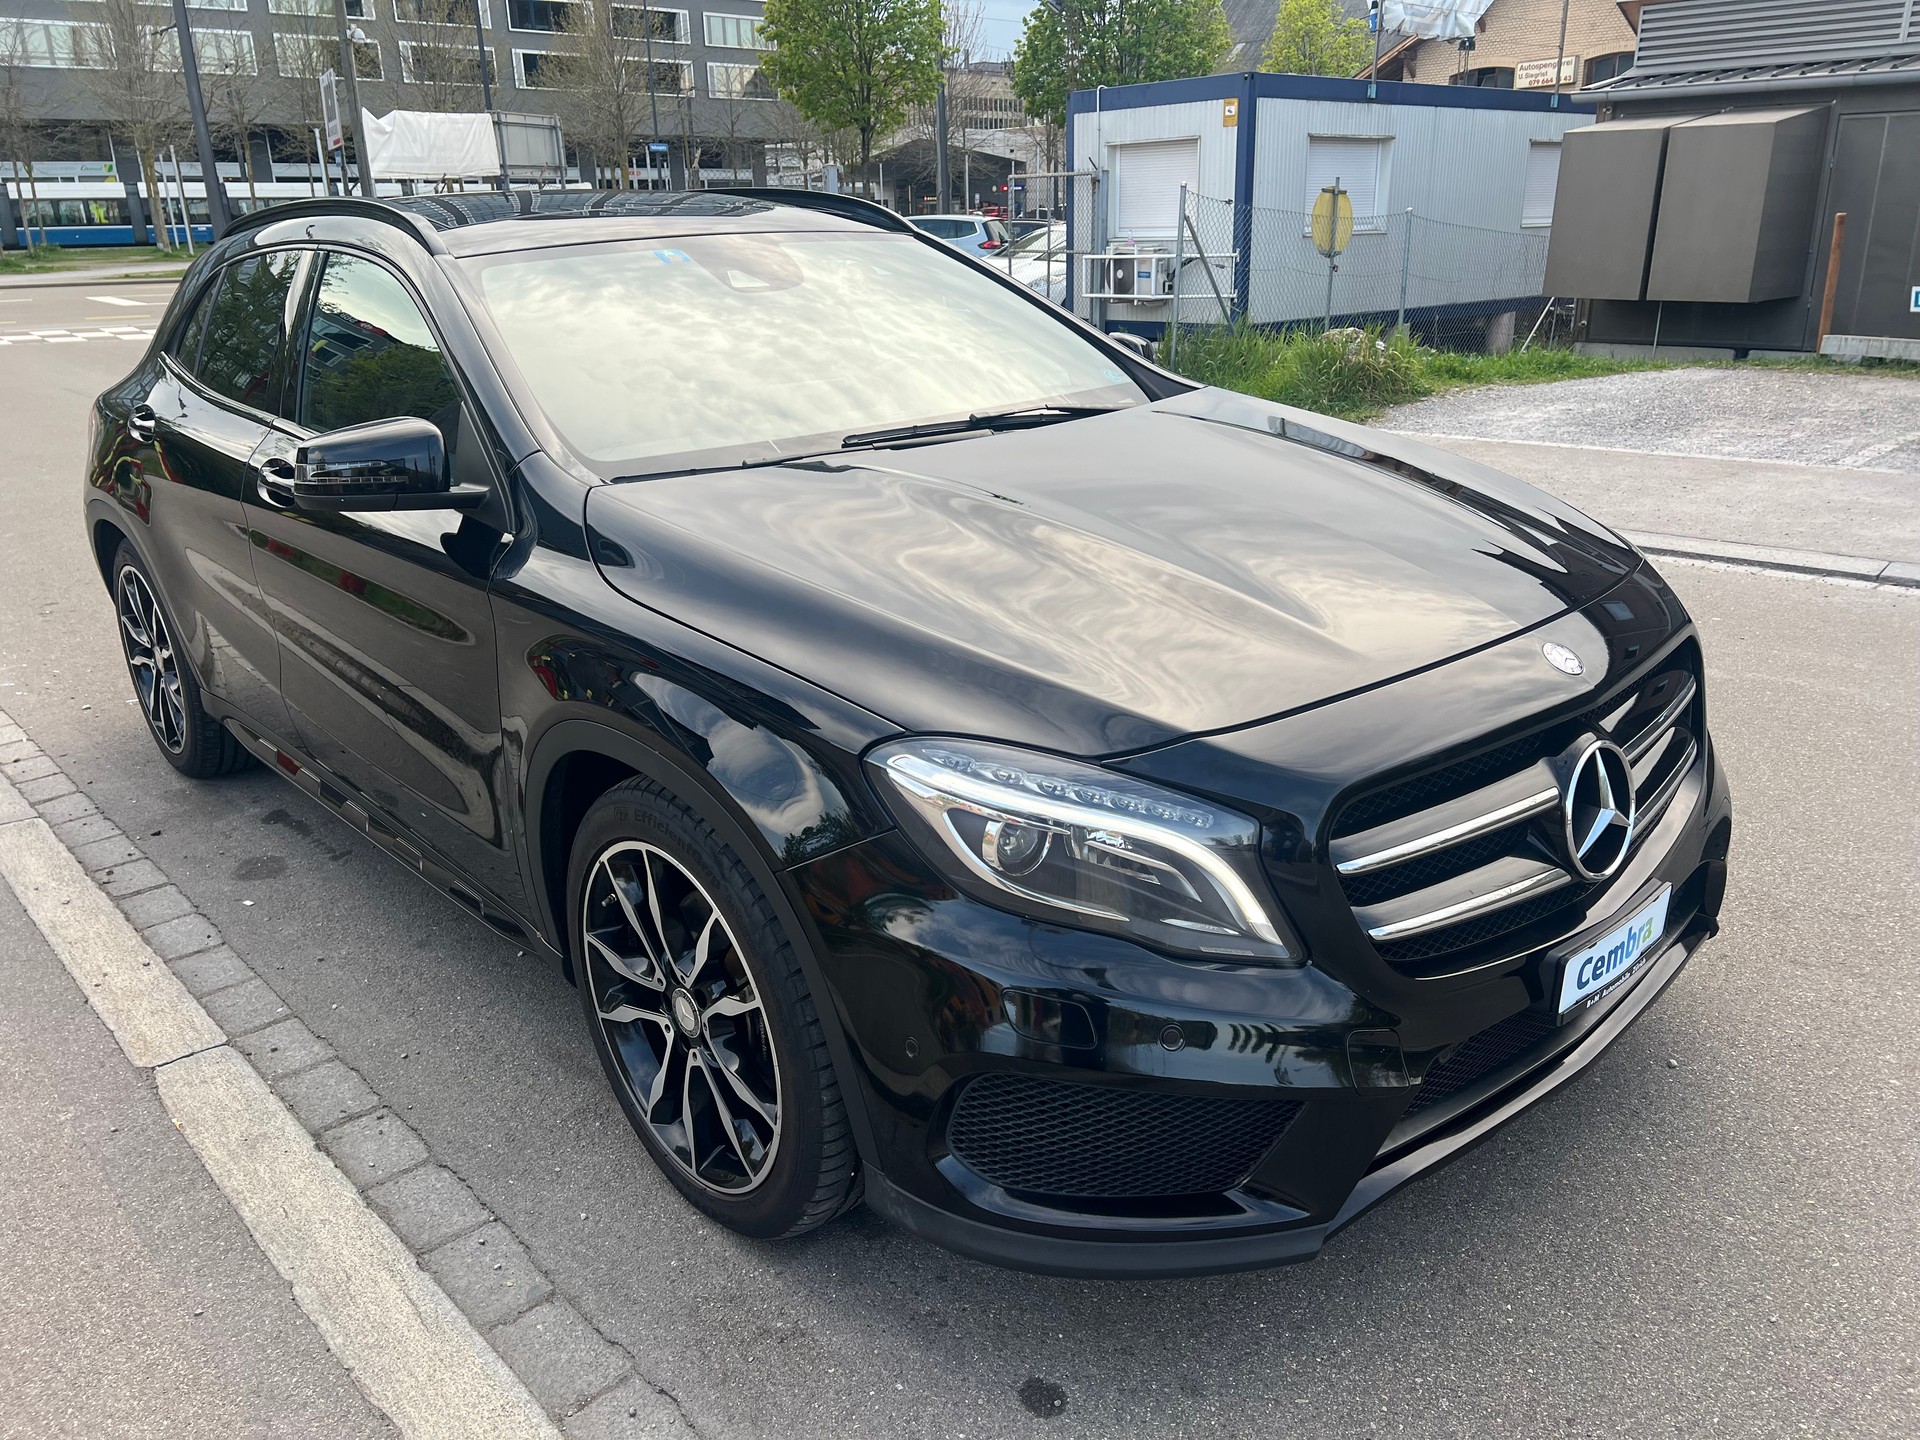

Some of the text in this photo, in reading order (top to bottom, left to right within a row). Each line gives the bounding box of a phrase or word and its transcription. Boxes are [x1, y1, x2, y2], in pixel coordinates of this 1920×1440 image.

[1519, 58, 1573, 71] Autospenglrei
[1525, 71, 1548, 79] Siegrist
[1577, 916, 1653, 990] Cembra
